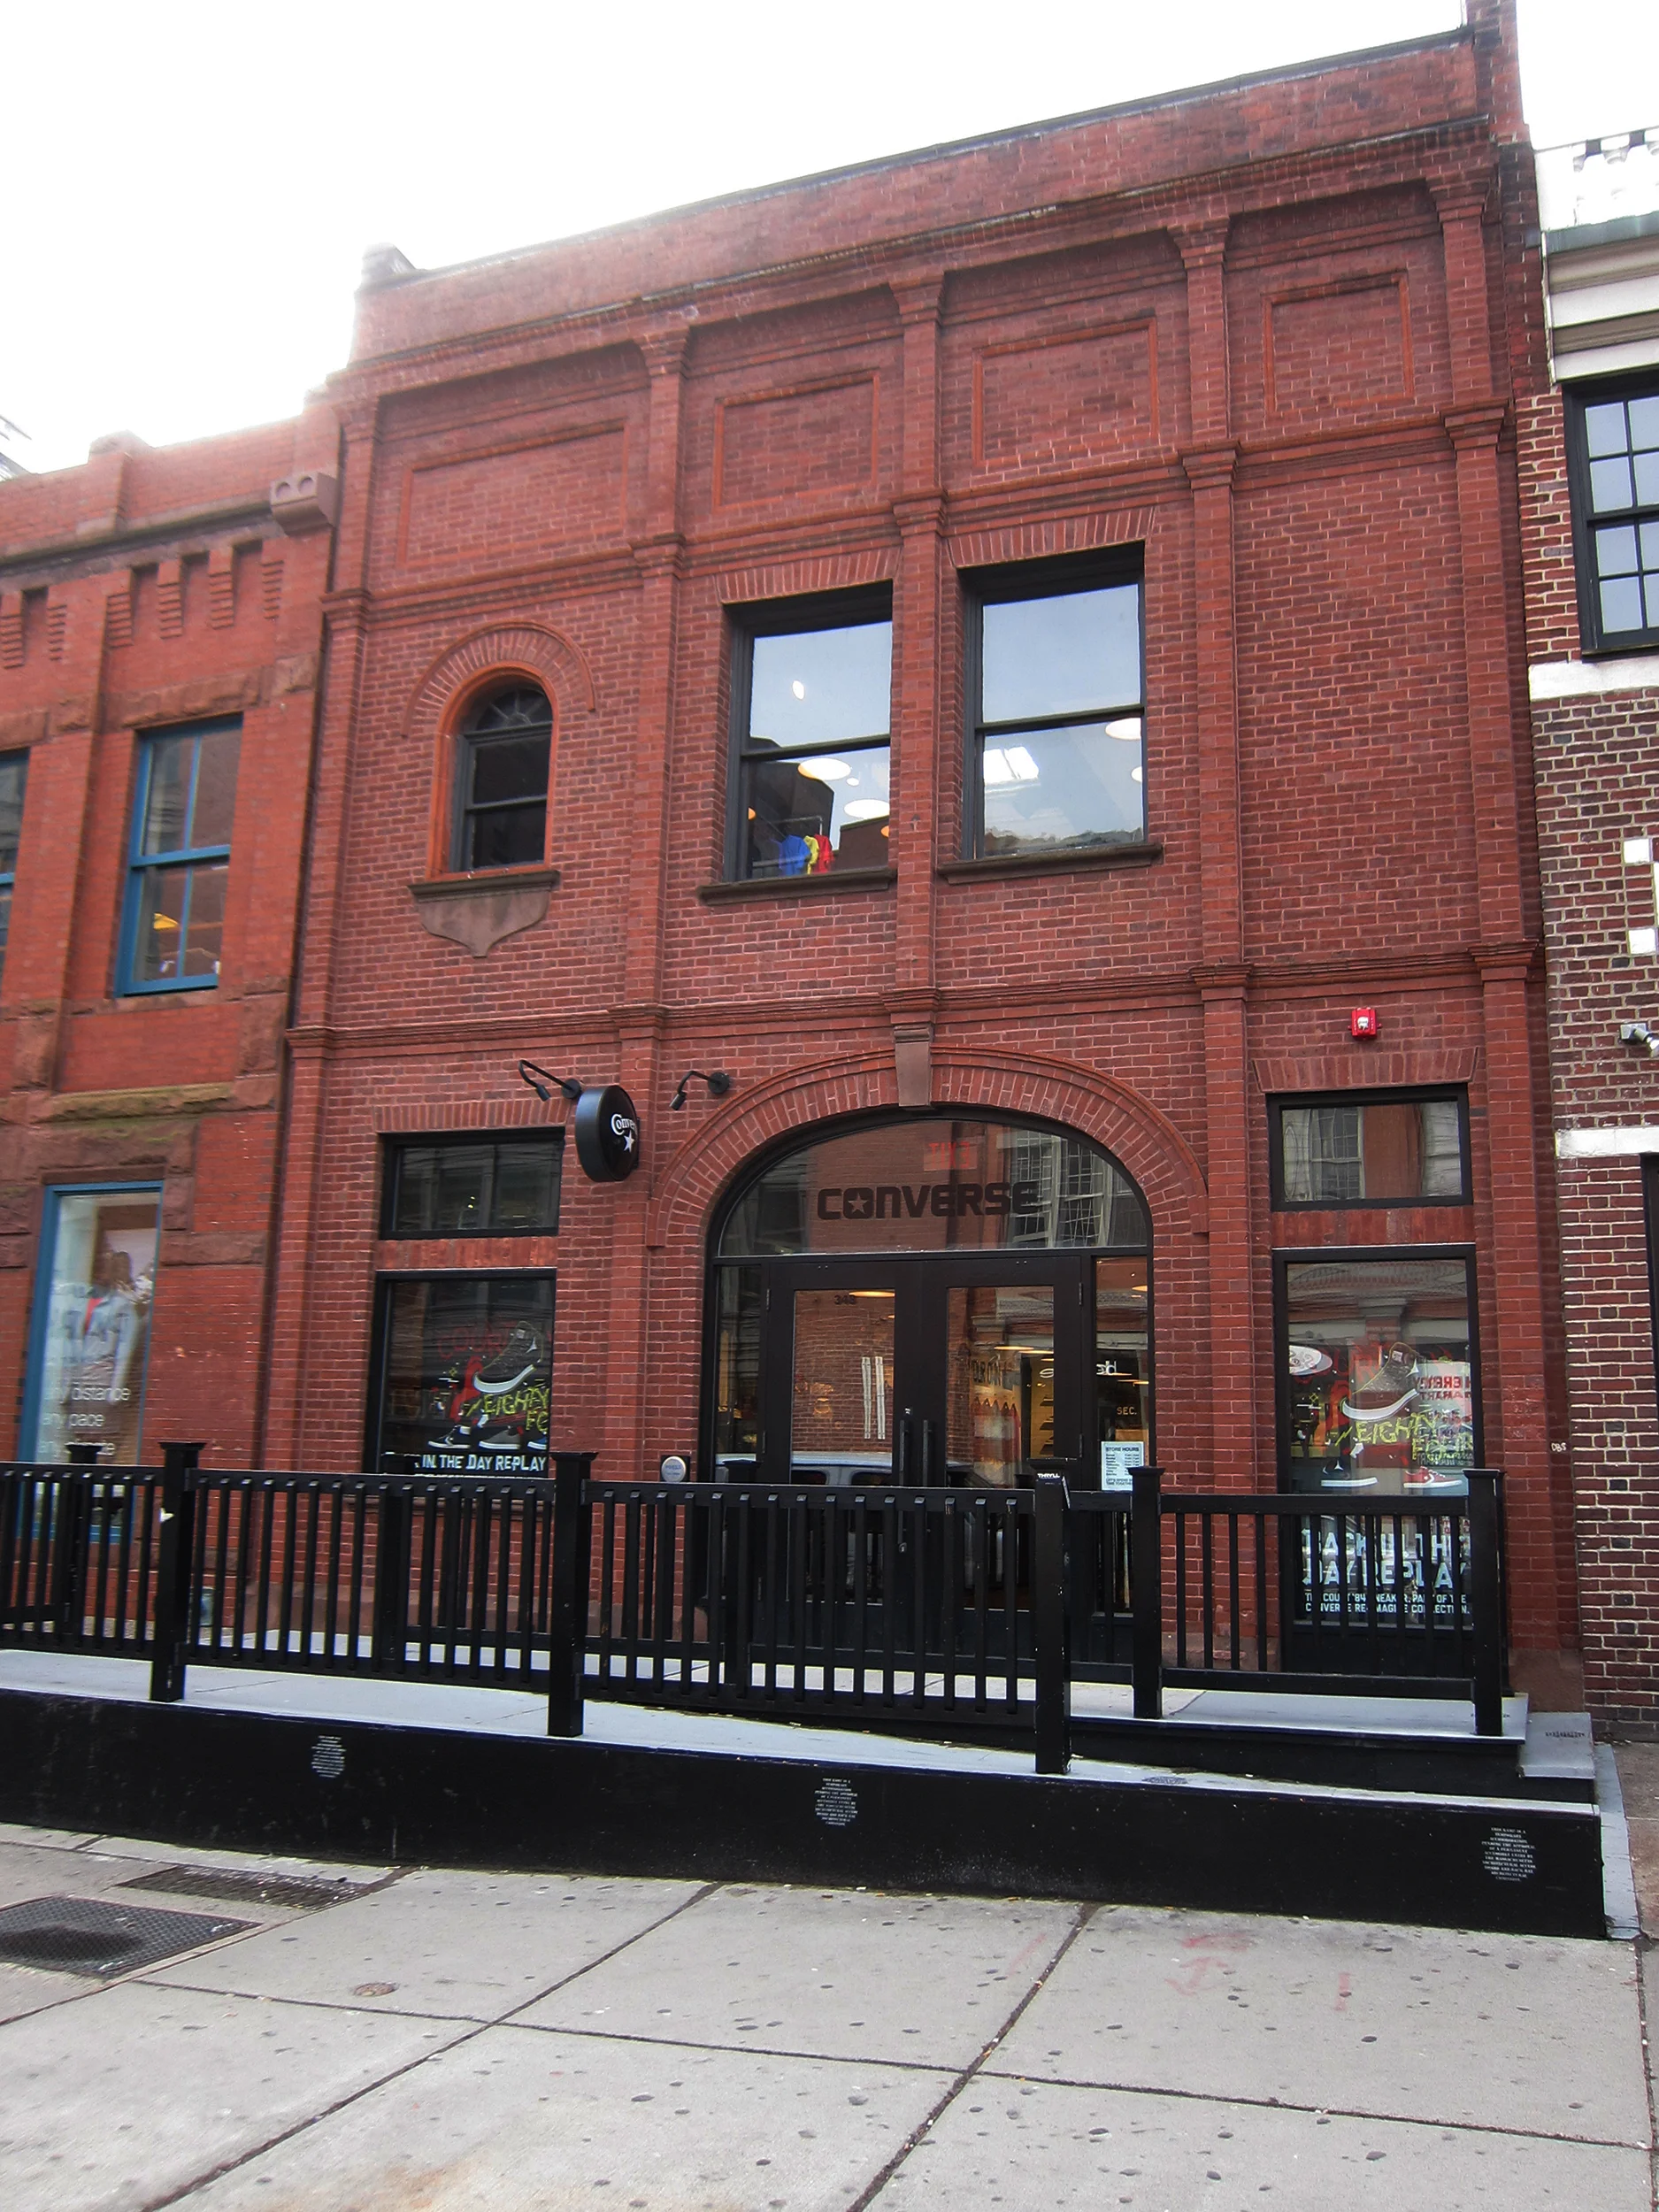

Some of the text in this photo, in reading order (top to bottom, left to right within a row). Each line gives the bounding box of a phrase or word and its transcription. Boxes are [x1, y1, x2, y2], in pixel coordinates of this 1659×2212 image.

[817, 1181, 1041, 1220] CONVERSE
[483, 1386, 549, 1416] EIGHTY
[1117, 1406, 1138, 1415] SEC.
[68, 1411, 106, 1429] pace
[439, 1454, 465, 1469] THE
[465, 1454, 494, 1471] DAY
[495, 1455, 547, 1472] REPLAY
[1436, 1594, 1448, 1603] OF
